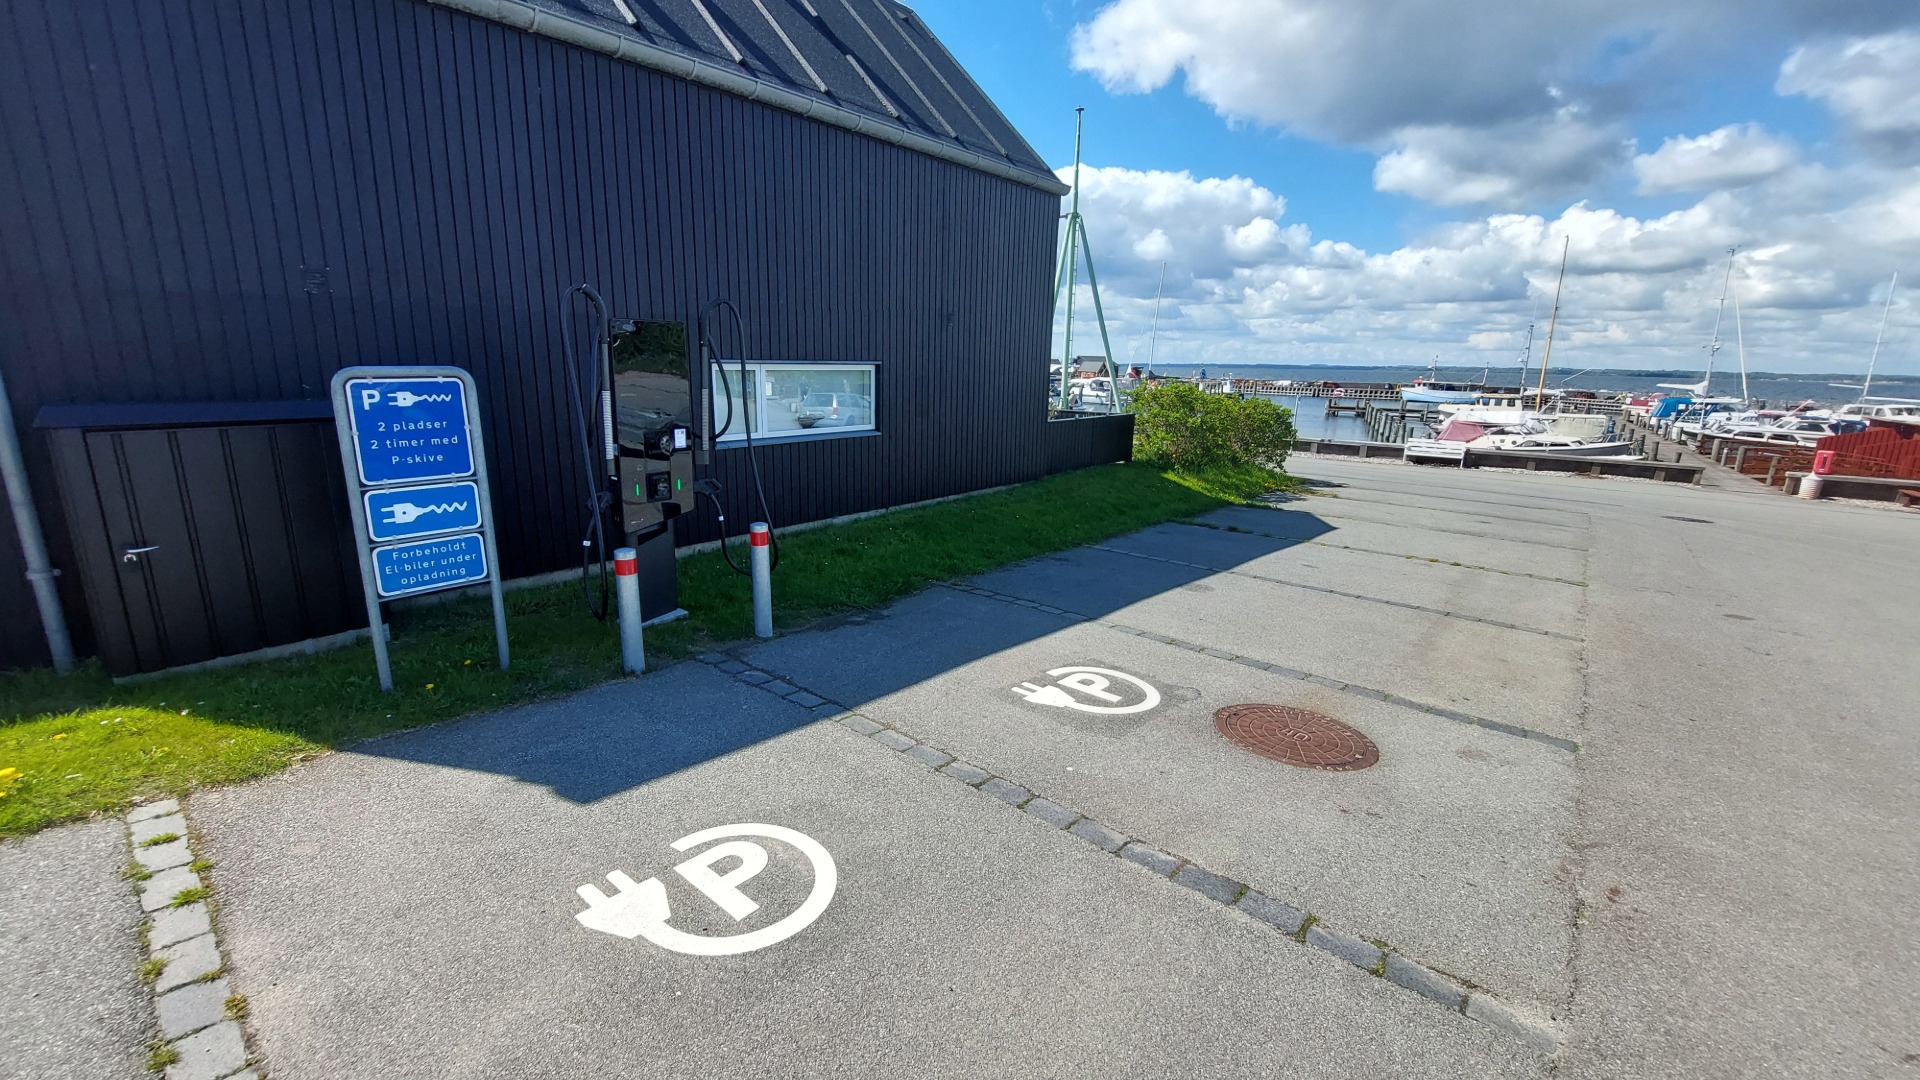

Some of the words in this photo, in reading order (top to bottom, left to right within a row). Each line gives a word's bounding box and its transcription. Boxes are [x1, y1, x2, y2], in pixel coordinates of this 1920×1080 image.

[361, 389, 381, 411] P
[377, 421, 386, 432] 2
[392, 420, 448, 433] pladser
[370, 439, 379, 450] 2
[385, 438, 425, 449] timer
[430, 434, 459, 446] med
[391, 453, 444, 465] P-skive
[392, 541, 467, 561] Forbeholdt
[385, 560, 436, 575] El-biler
[440, 553, 477, 566] under
[400, 567, 466, 585] opladning
[1056, 672, 1124, 703] P
[672, 840, 769, 922] P
